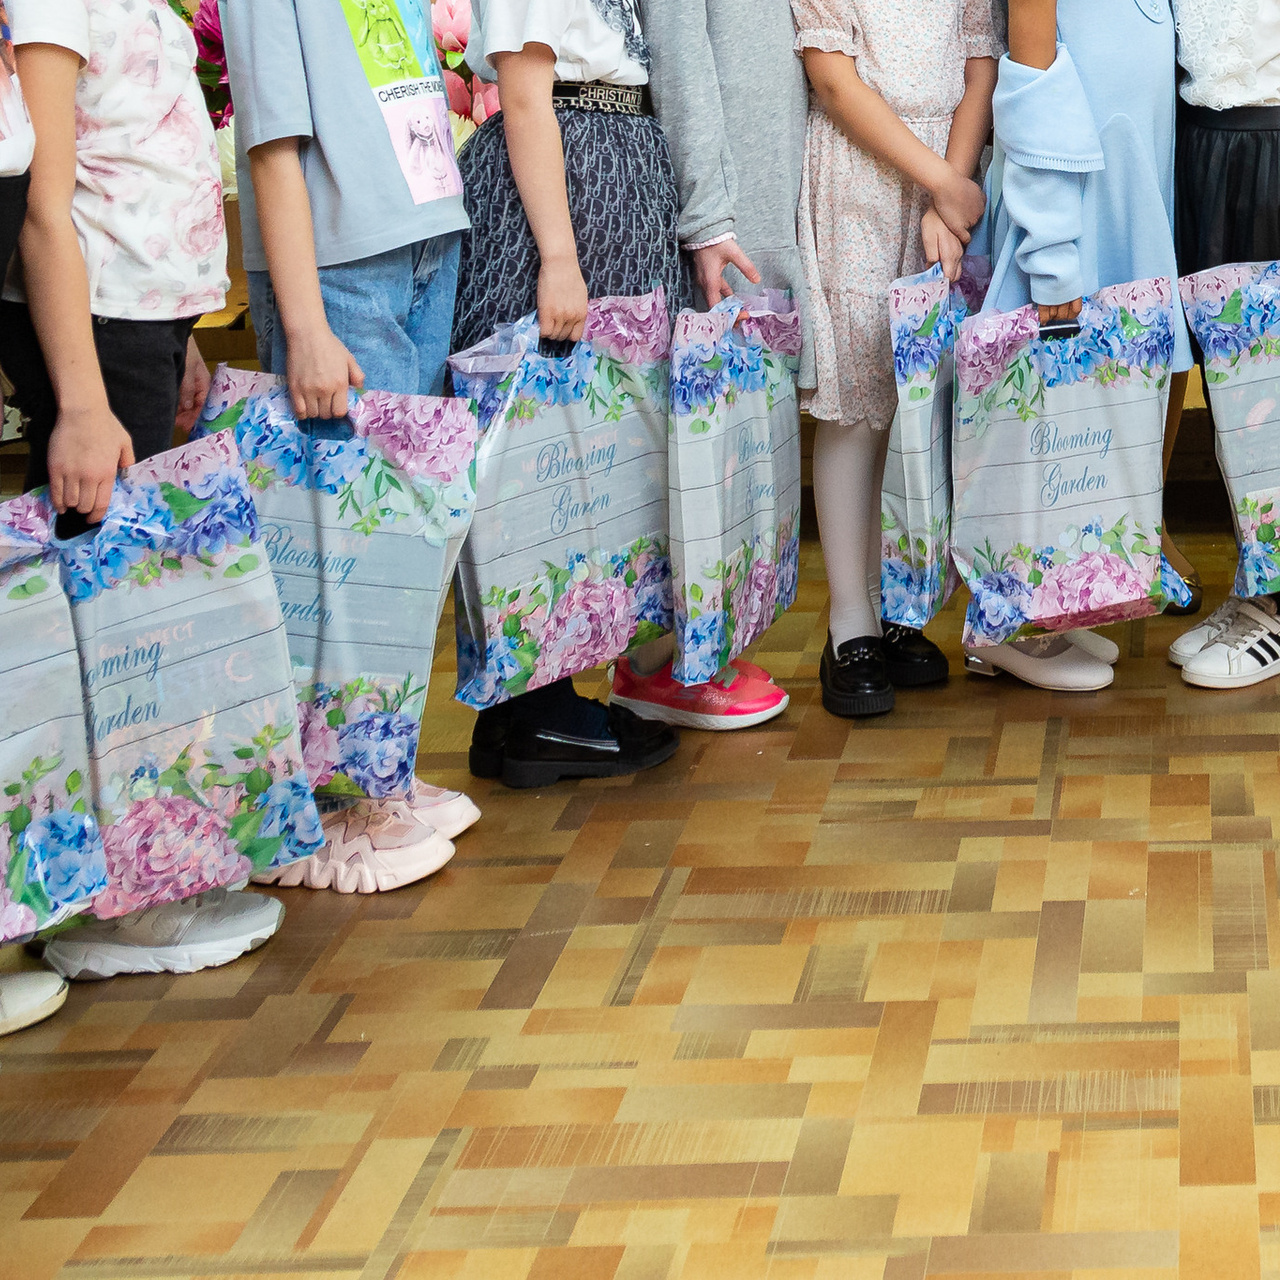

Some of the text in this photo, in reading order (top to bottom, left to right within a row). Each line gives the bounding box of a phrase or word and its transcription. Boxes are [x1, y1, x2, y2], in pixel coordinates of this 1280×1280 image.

[378, 84, 419, 102] CHERISH
[419, 81, 433, 93] THE
[579, 87, 638, 105] CHRISTIAN
[1030, 421, 1114, 459] Blooming
[1041, 462, 1109, 508] Garden
[272, 575, 334, 627] arden
